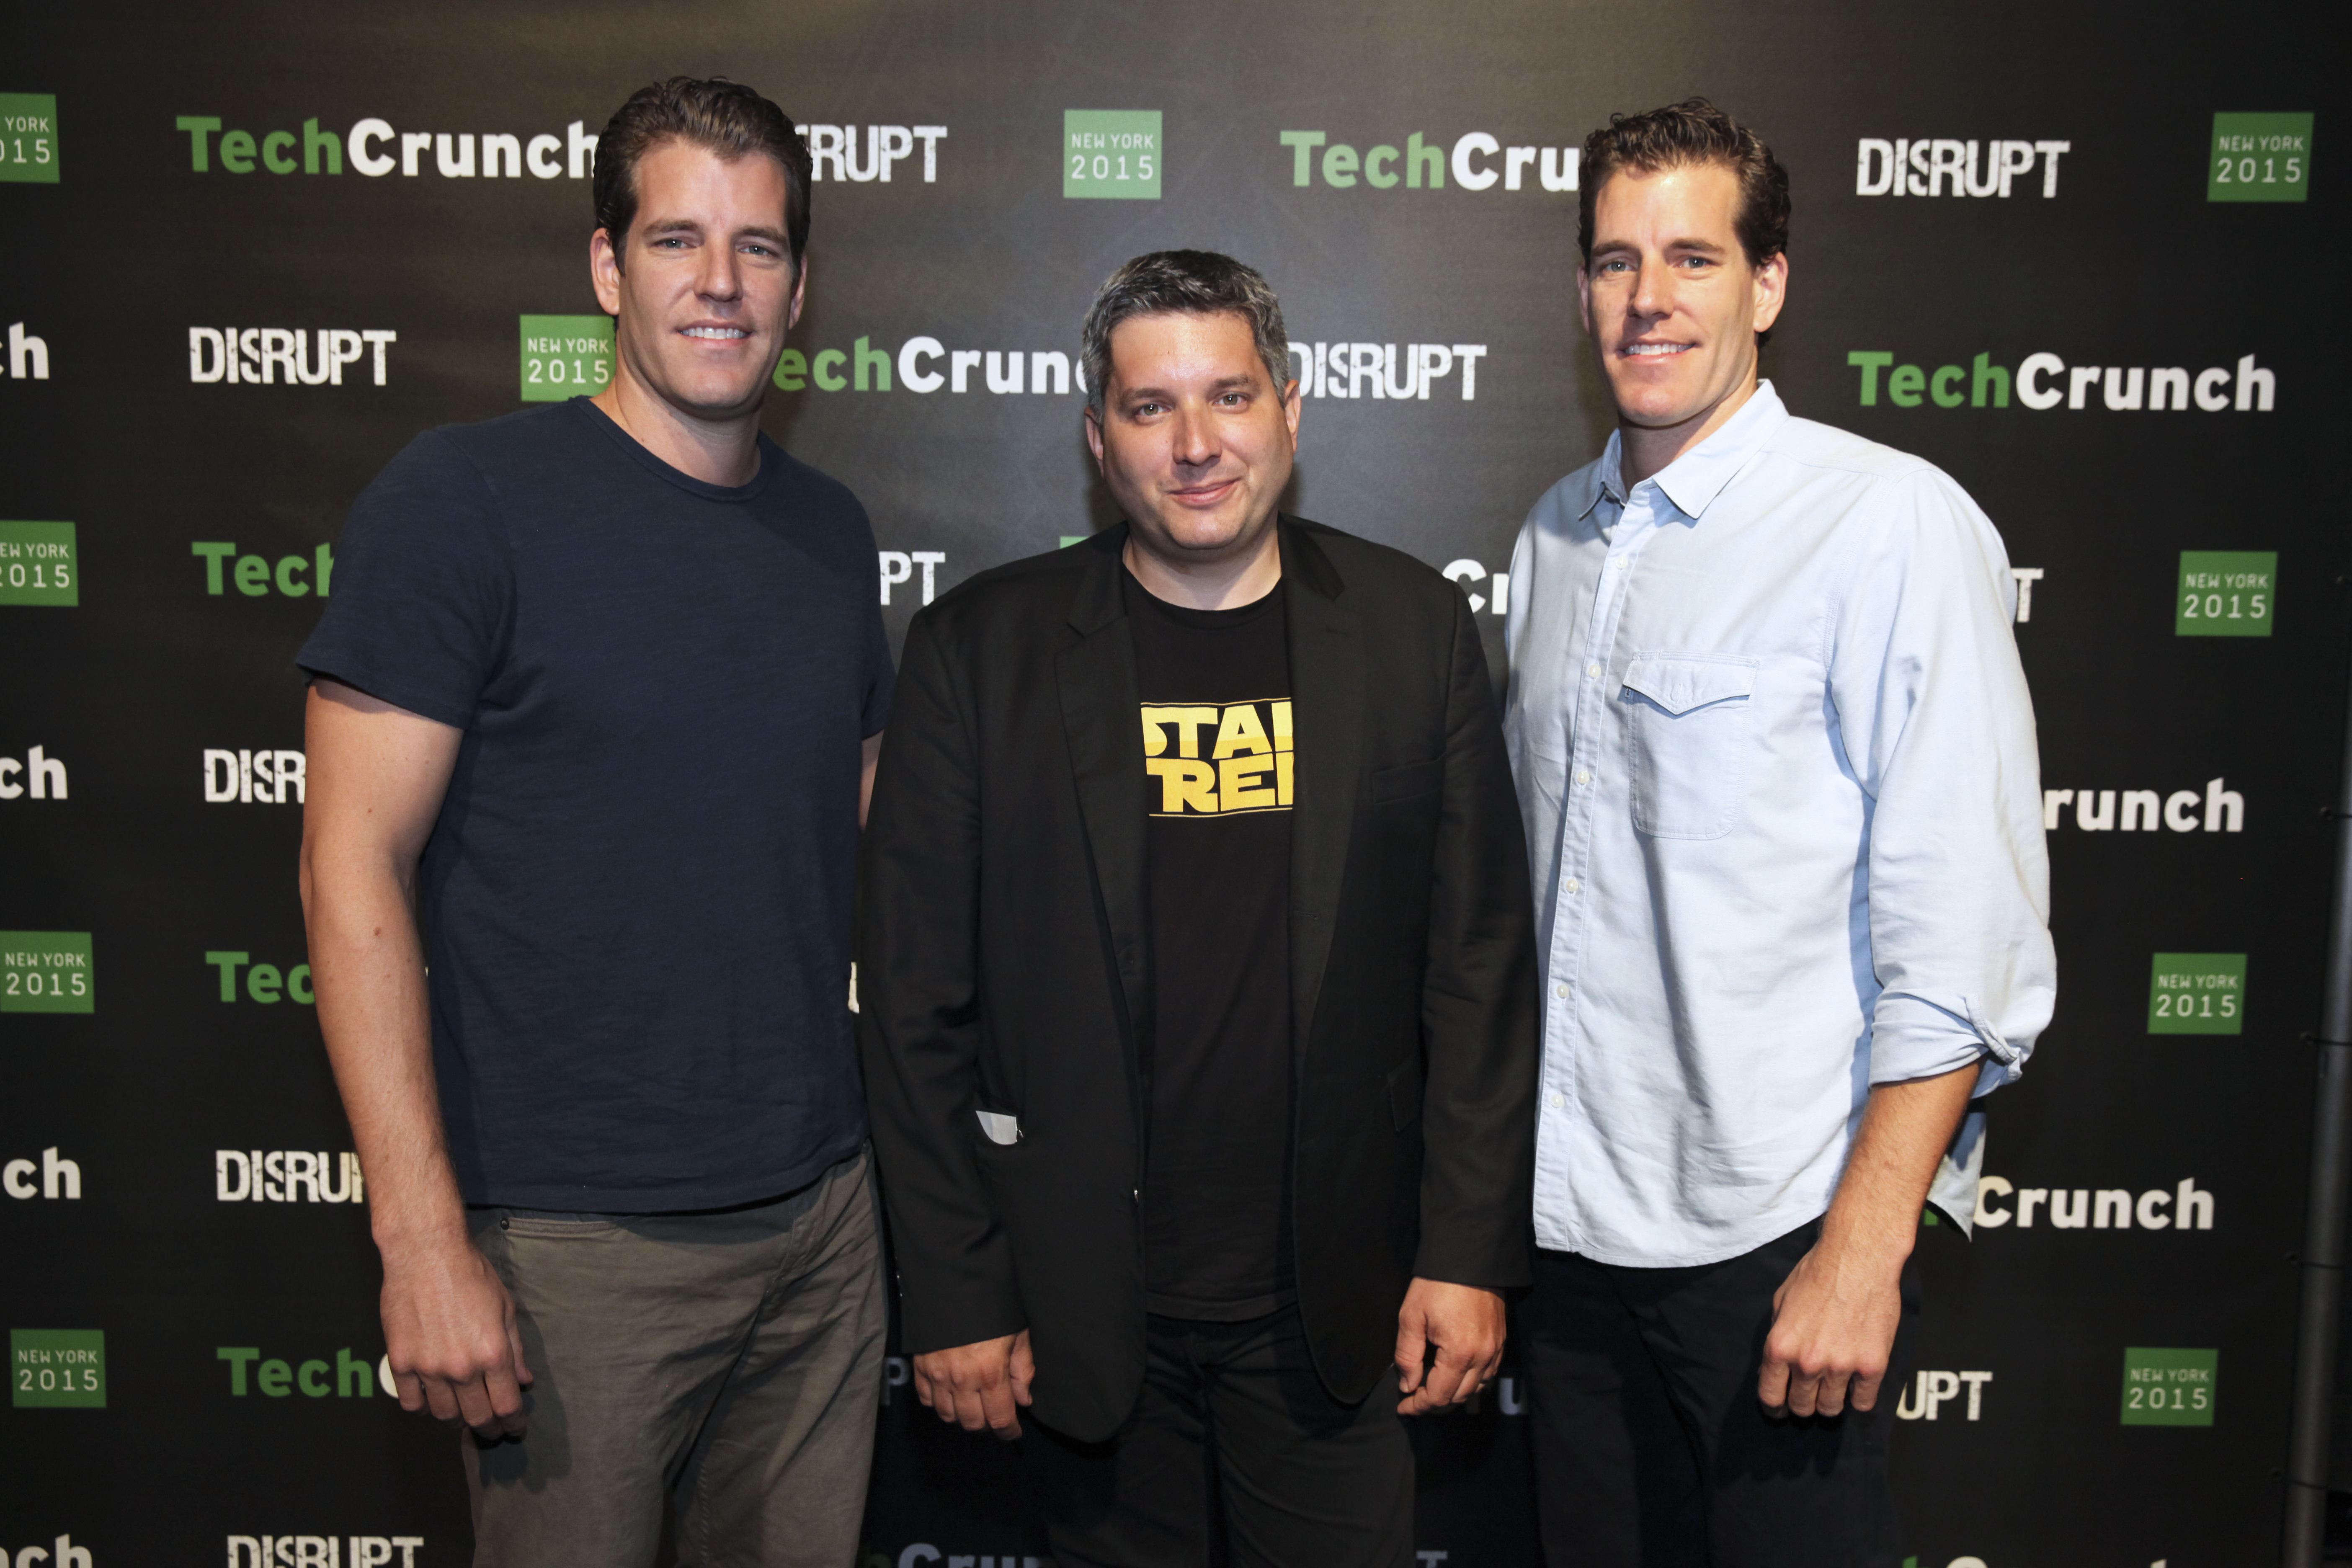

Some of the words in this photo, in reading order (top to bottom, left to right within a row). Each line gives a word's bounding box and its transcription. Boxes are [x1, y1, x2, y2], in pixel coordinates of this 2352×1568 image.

[4, 116, 50, 133] YORK
[176, 116, 600, 179] TechCrunch
[1071, 132, 1106, 149] NEW
[1110, 133, 1155, 150] YORK
[2219, 135, 2255, 152] NEW
[2259, 135, 2304, 152] YORK
[1071, 154, 1154, 181] 2015
[1280, 131, 1580, 192] TechCru
[1856, 138, 2071, 198] DISRUPT
[2216, 157, 2301, 183] 2015
[189, 327, 397, 386] DISRUPT
[527, 337, 561, 353] NEW
[565, 338, 609, 353] YORK
[528, 358, 609, 384] 2015
[1847, 351, 2276, 412] TechCrunch
[25, 542, 70, 559] YORK
[0, 563, 70, 588] 015
[2186, 573, 2220, 588] NEW
[2224, 573, 2269, 589] YORK
[2184, 593, 2266, 619] 2015
[204, 748, 306, 804] DISR
[5, 952, 38, 967] NEW
[42, 952, 86, 968] YORK
[6, 972, 86, 996] 2015
[2158, 974, 2192, 989] NEW
[2195, 974, 2239, 990] YORK
[2156, 994, 2236, 1018] 2015
[18, 1349, 51, 1364] NEW
[55, 1350, 98, 1364] YORK
[19, 1369, 98, 1391] 2015
[2130, 1368, 2164, 1382] NEW
[2167, 1368, 2210, 1382] YORK
[2128, 1387, 2208, 1410] 2015
